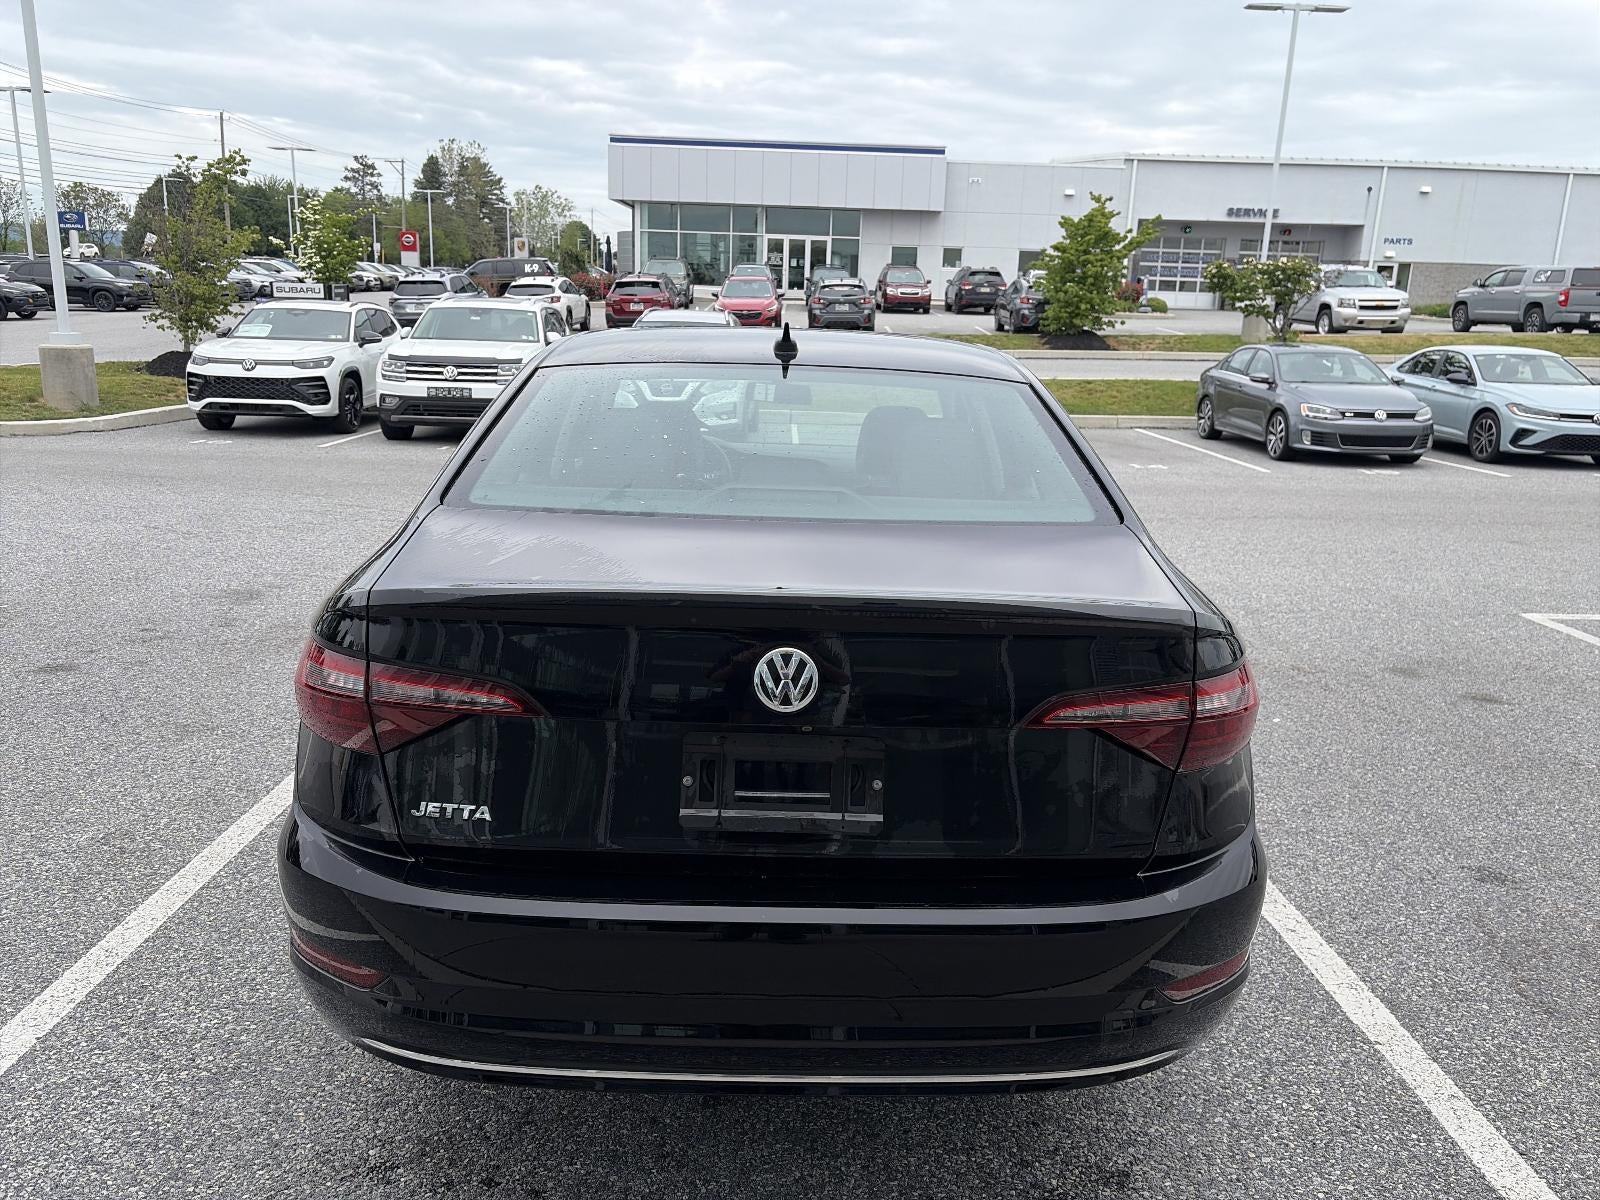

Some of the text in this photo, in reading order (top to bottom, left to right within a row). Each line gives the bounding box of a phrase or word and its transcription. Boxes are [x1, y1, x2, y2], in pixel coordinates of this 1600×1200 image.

[1383, 237, 1414, 246] PARTS
[524, 263, 540, 273] K-9
[275, 286, 321, 295] SUBARU
[753, 647, 819, 713] VW
[410, 801, 493, 823] JETTA
